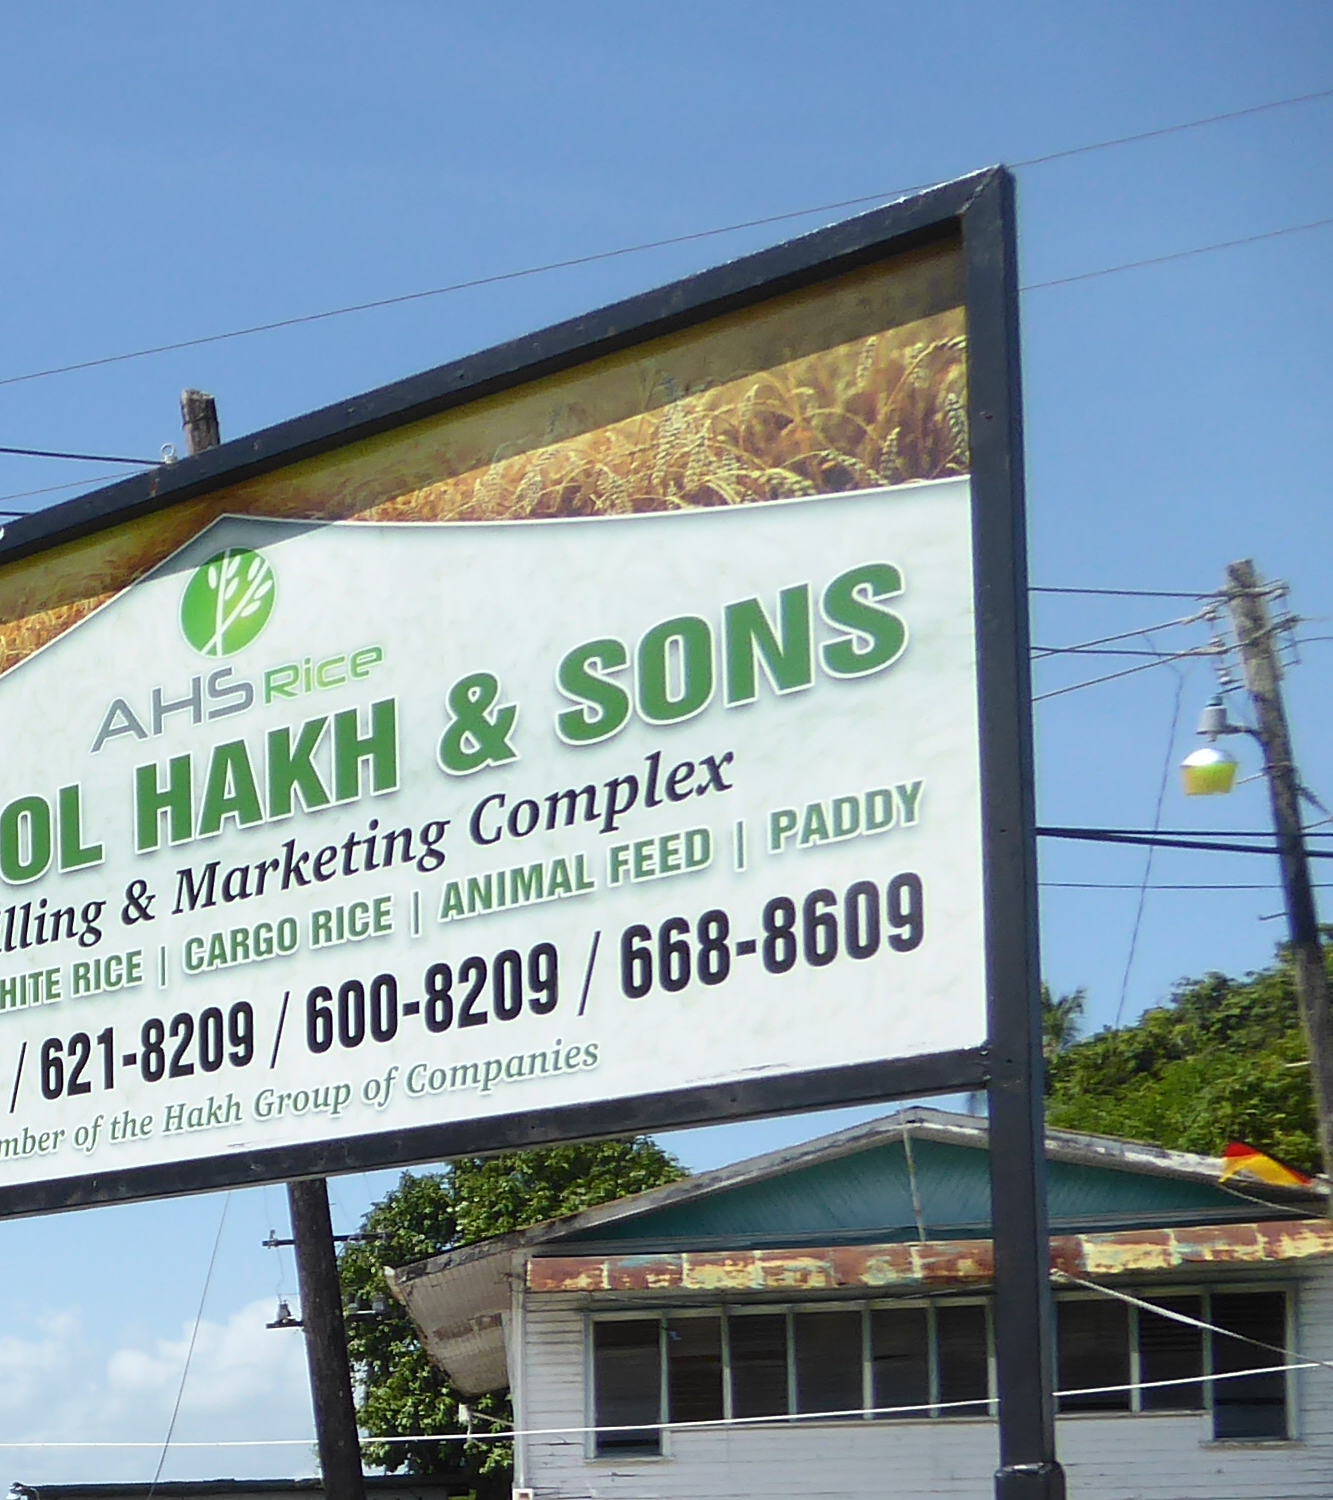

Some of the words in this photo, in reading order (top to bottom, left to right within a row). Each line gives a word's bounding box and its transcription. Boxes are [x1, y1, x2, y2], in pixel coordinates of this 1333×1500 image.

[136, 697, 398, 853] HAKH
[439, 672, 517, 780] &
[558, 563, 905, 749] SONS
[73, 949, 143, 995] RICE
[185, 917, 298, 971] CARGO
[312, 895, 392, 946] RICE
[440, 854, 595, 919] ANIMAL
[610, 828, 710, 884] FEED
[771, 781, 922, 850] PADDY
[121, 879, 157, 926] &
[171, 819, 452, 915] Marketing
[469, 750, 734, 846] Complex
[9, 1041, 28, 1114] /
[40, 1000, 254, 1100] 621-8209
[269, 990, 290, 1070] /
[306, 942, 559, 1054] 600-8209
[577, 930, 601, 1017] /
[620, 872, 924, 999] 668-8609
[74, 1114, 104, 1152] of
[111, 1110, 153, 1140] the
[163, 1093, 243, 1132] Hakh
[254, 1083, 351, 1119] Group
[363, 1066, 399, 1107] of
[407, 1040, 598, 1094] Companies
